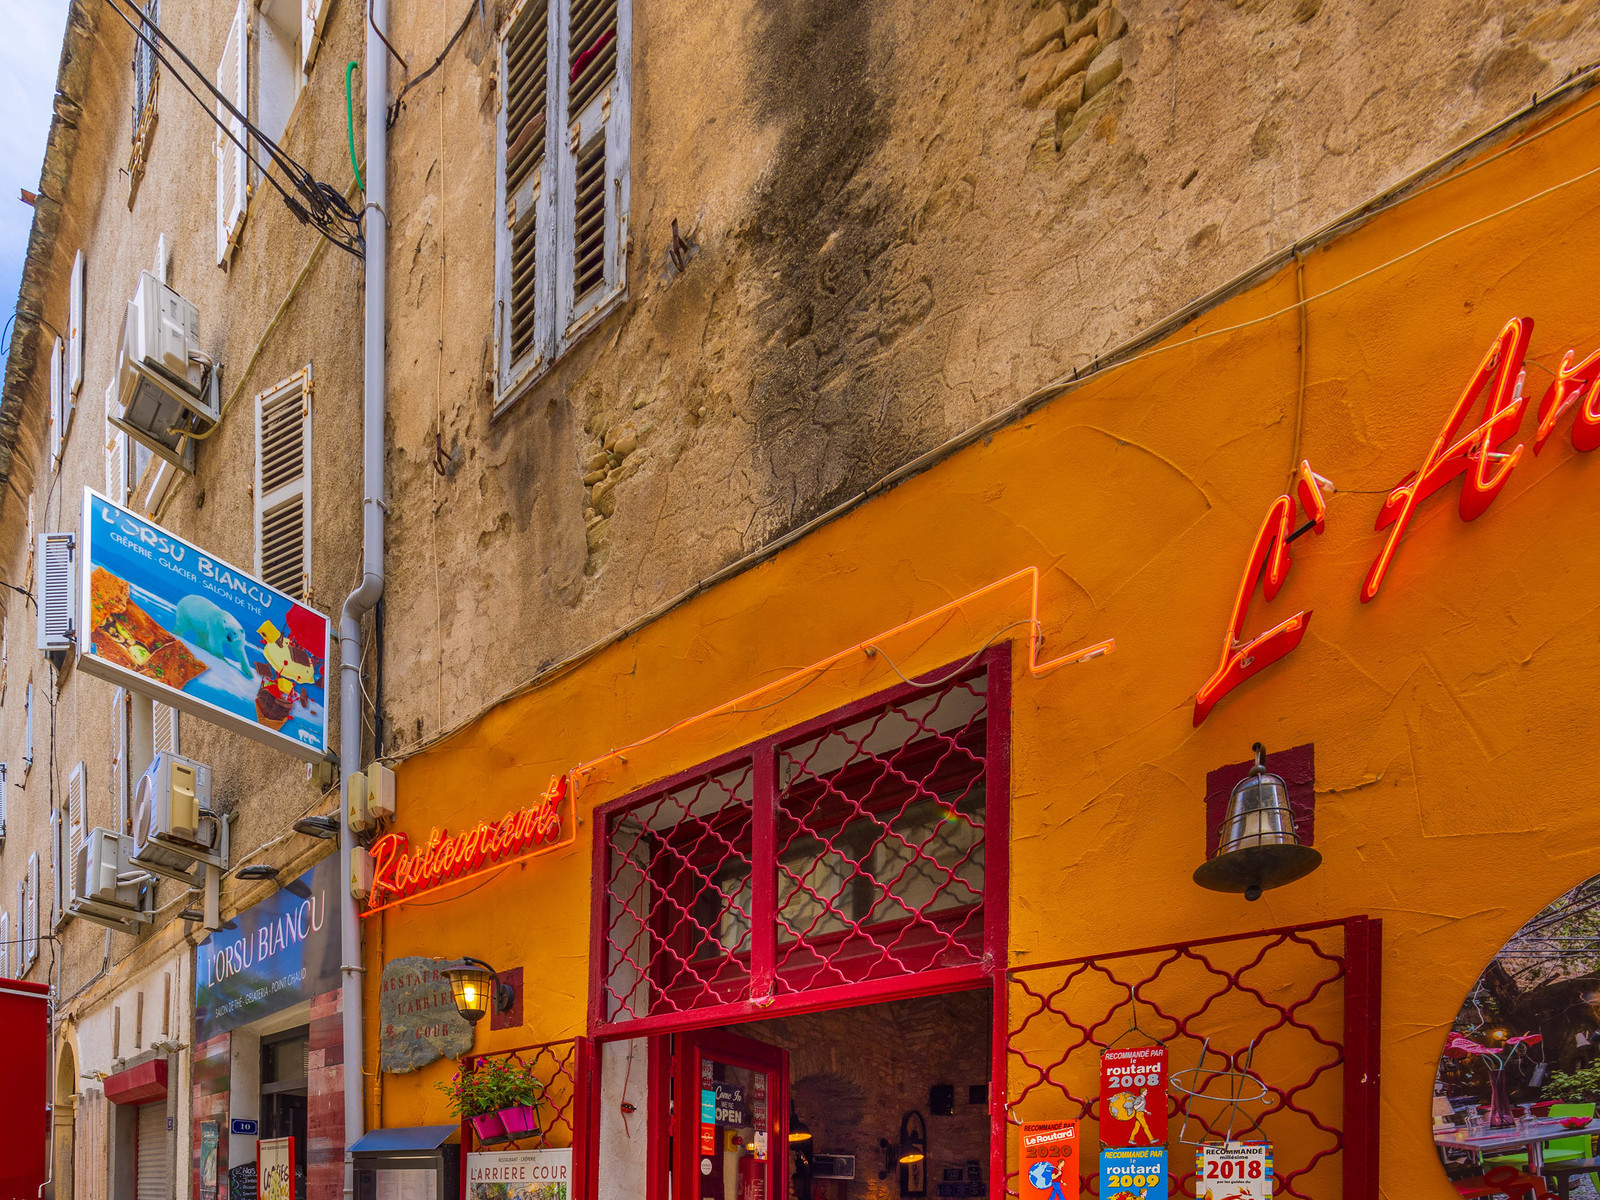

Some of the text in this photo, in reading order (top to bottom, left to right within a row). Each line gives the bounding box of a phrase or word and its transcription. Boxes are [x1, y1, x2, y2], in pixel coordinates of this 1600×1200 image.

[102, 507, 272, 608] L'ORSU BIANCU
[110, 531, 262, 616] CRÊPERIE GLACIER SALON DE THÉ
[368, 775, 562, 908] Restaurant
[208, 890, 325, 988] L'ORSU BIANCU
[272, 977, 287, 994] POINT
[1150, 1049, 1163, 1057] PAR
[1107, 1062, 1161, 1075] routard
[1108, 1074, 1160, 1088] 2008
[715, 1085, 732, 1100] Come
[715, 1107, 742, 1124] OPEN
[1036, 1128, 1073, 1143] Routard
[1026, 1145, 1072, 1158] 2020
[470, 1165, 567, 1180] L'ARRIERE COUR
[1107, 1163, 1160, 1174] routard
[1206, 1160, 1262, 1179] 2018
[1108, 1174, 1160, 1188] 2009
